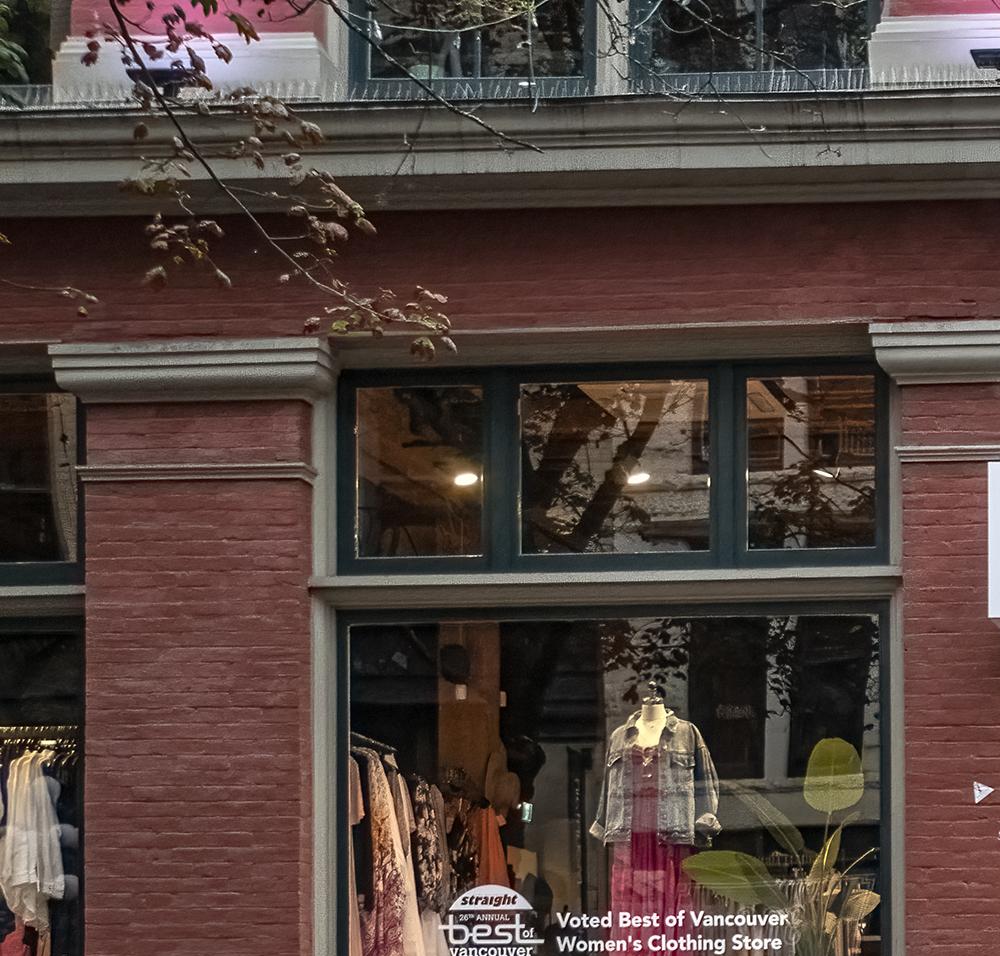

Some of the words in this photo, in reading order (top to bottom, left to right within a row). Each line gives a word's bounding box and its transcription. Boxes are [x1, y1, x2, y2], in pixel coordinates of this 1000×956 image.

[461, 894, 518, 907] straight
[556, 911, 613, 928] Voted
[618, 911, 660, 928] Best
[665, 910, 686, 927] of
[690, 910, 789, 927] Vancouver
[438, 913, 545, 945] best
[522, 927, 535, 938] of
[556, 936, 643, 952] Women's
[647, 934, 726, 955] Clothing
[732, 934, 783, 950] Store
